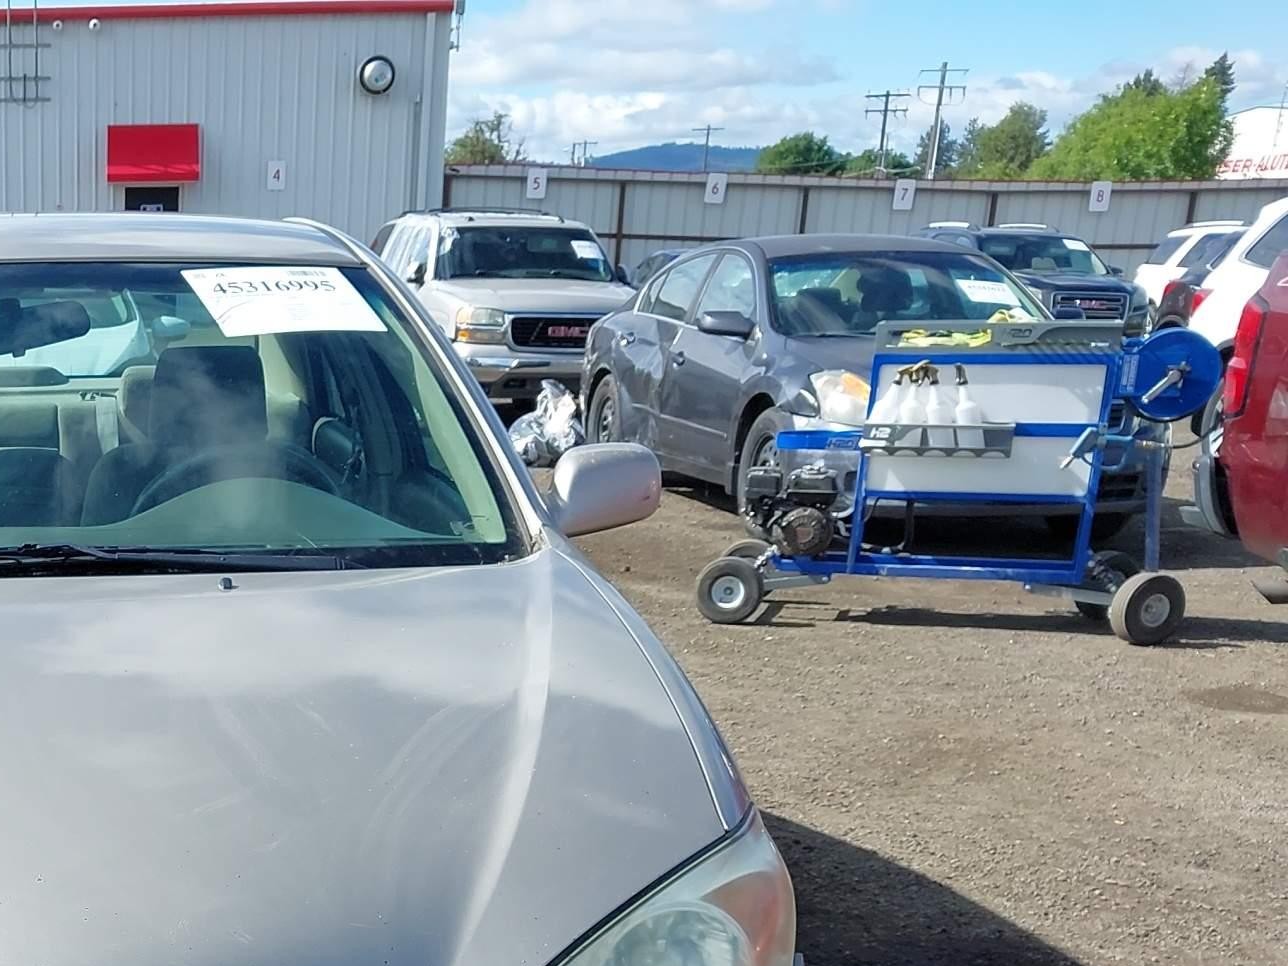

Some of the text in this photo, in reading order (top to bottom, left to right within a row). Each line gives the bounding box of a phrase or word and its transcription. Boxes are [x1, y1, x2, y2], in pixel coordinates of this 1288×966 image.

[272, 168, 281, 182] 4
[532, 176, 541, 190] 5
[711, 183, 720, 195] 6
[900, 187, 909, 201] 7
[1096, 189, 1105, 203] 8
[213, 280, 336, 294] 45316995
[548, 326, 590, 337] GMC
